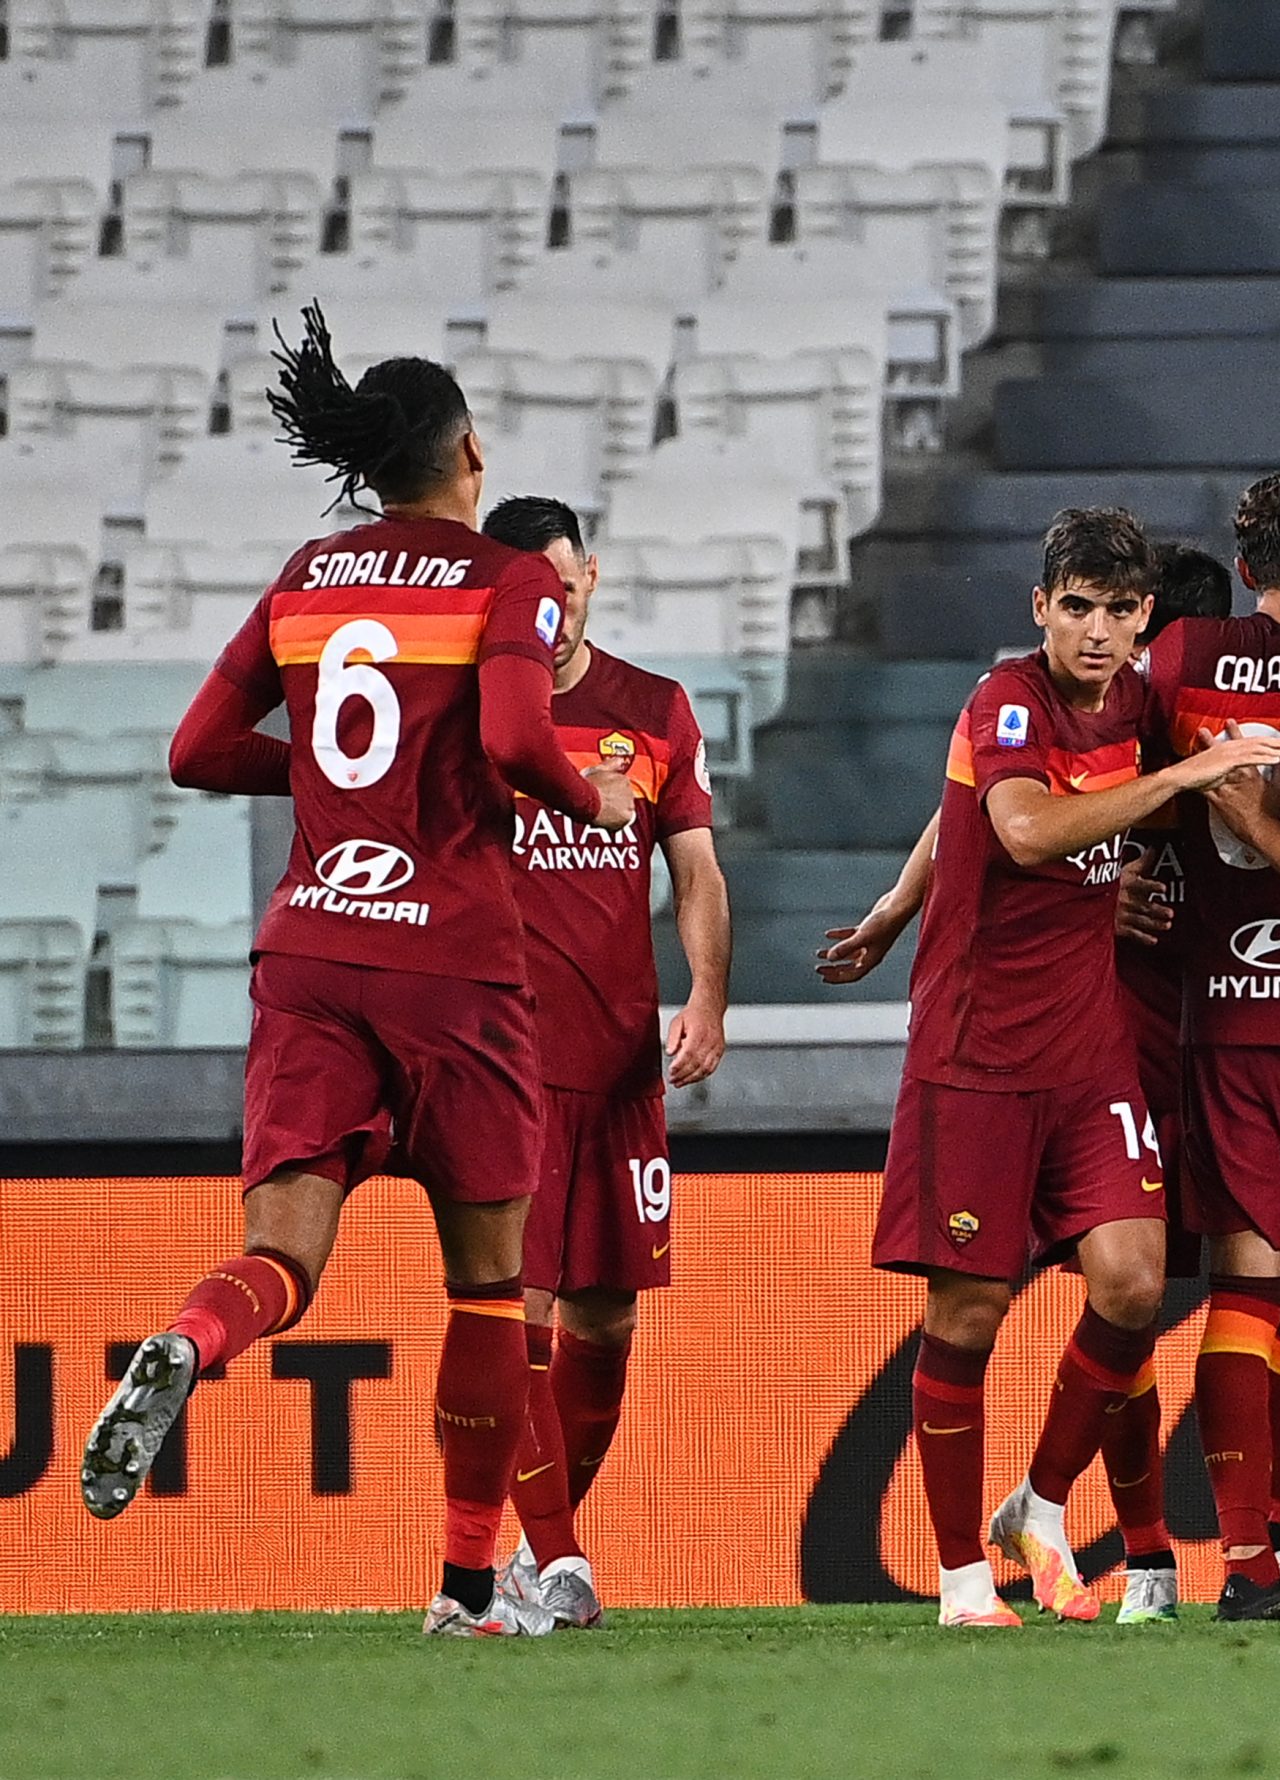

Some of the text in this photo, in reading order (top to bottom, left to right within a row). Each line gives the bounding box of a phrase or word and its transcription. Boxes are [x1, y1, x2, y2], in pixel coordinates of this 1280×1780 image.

[302, 549, 472, 591] SMALLING
[311, 618, 401, 790] 6
[527, 845, 640, 871] AIRWAYS
[289, 883, 430, 927] HYUNDAI
[628, 1157, 671, 1223] 19
